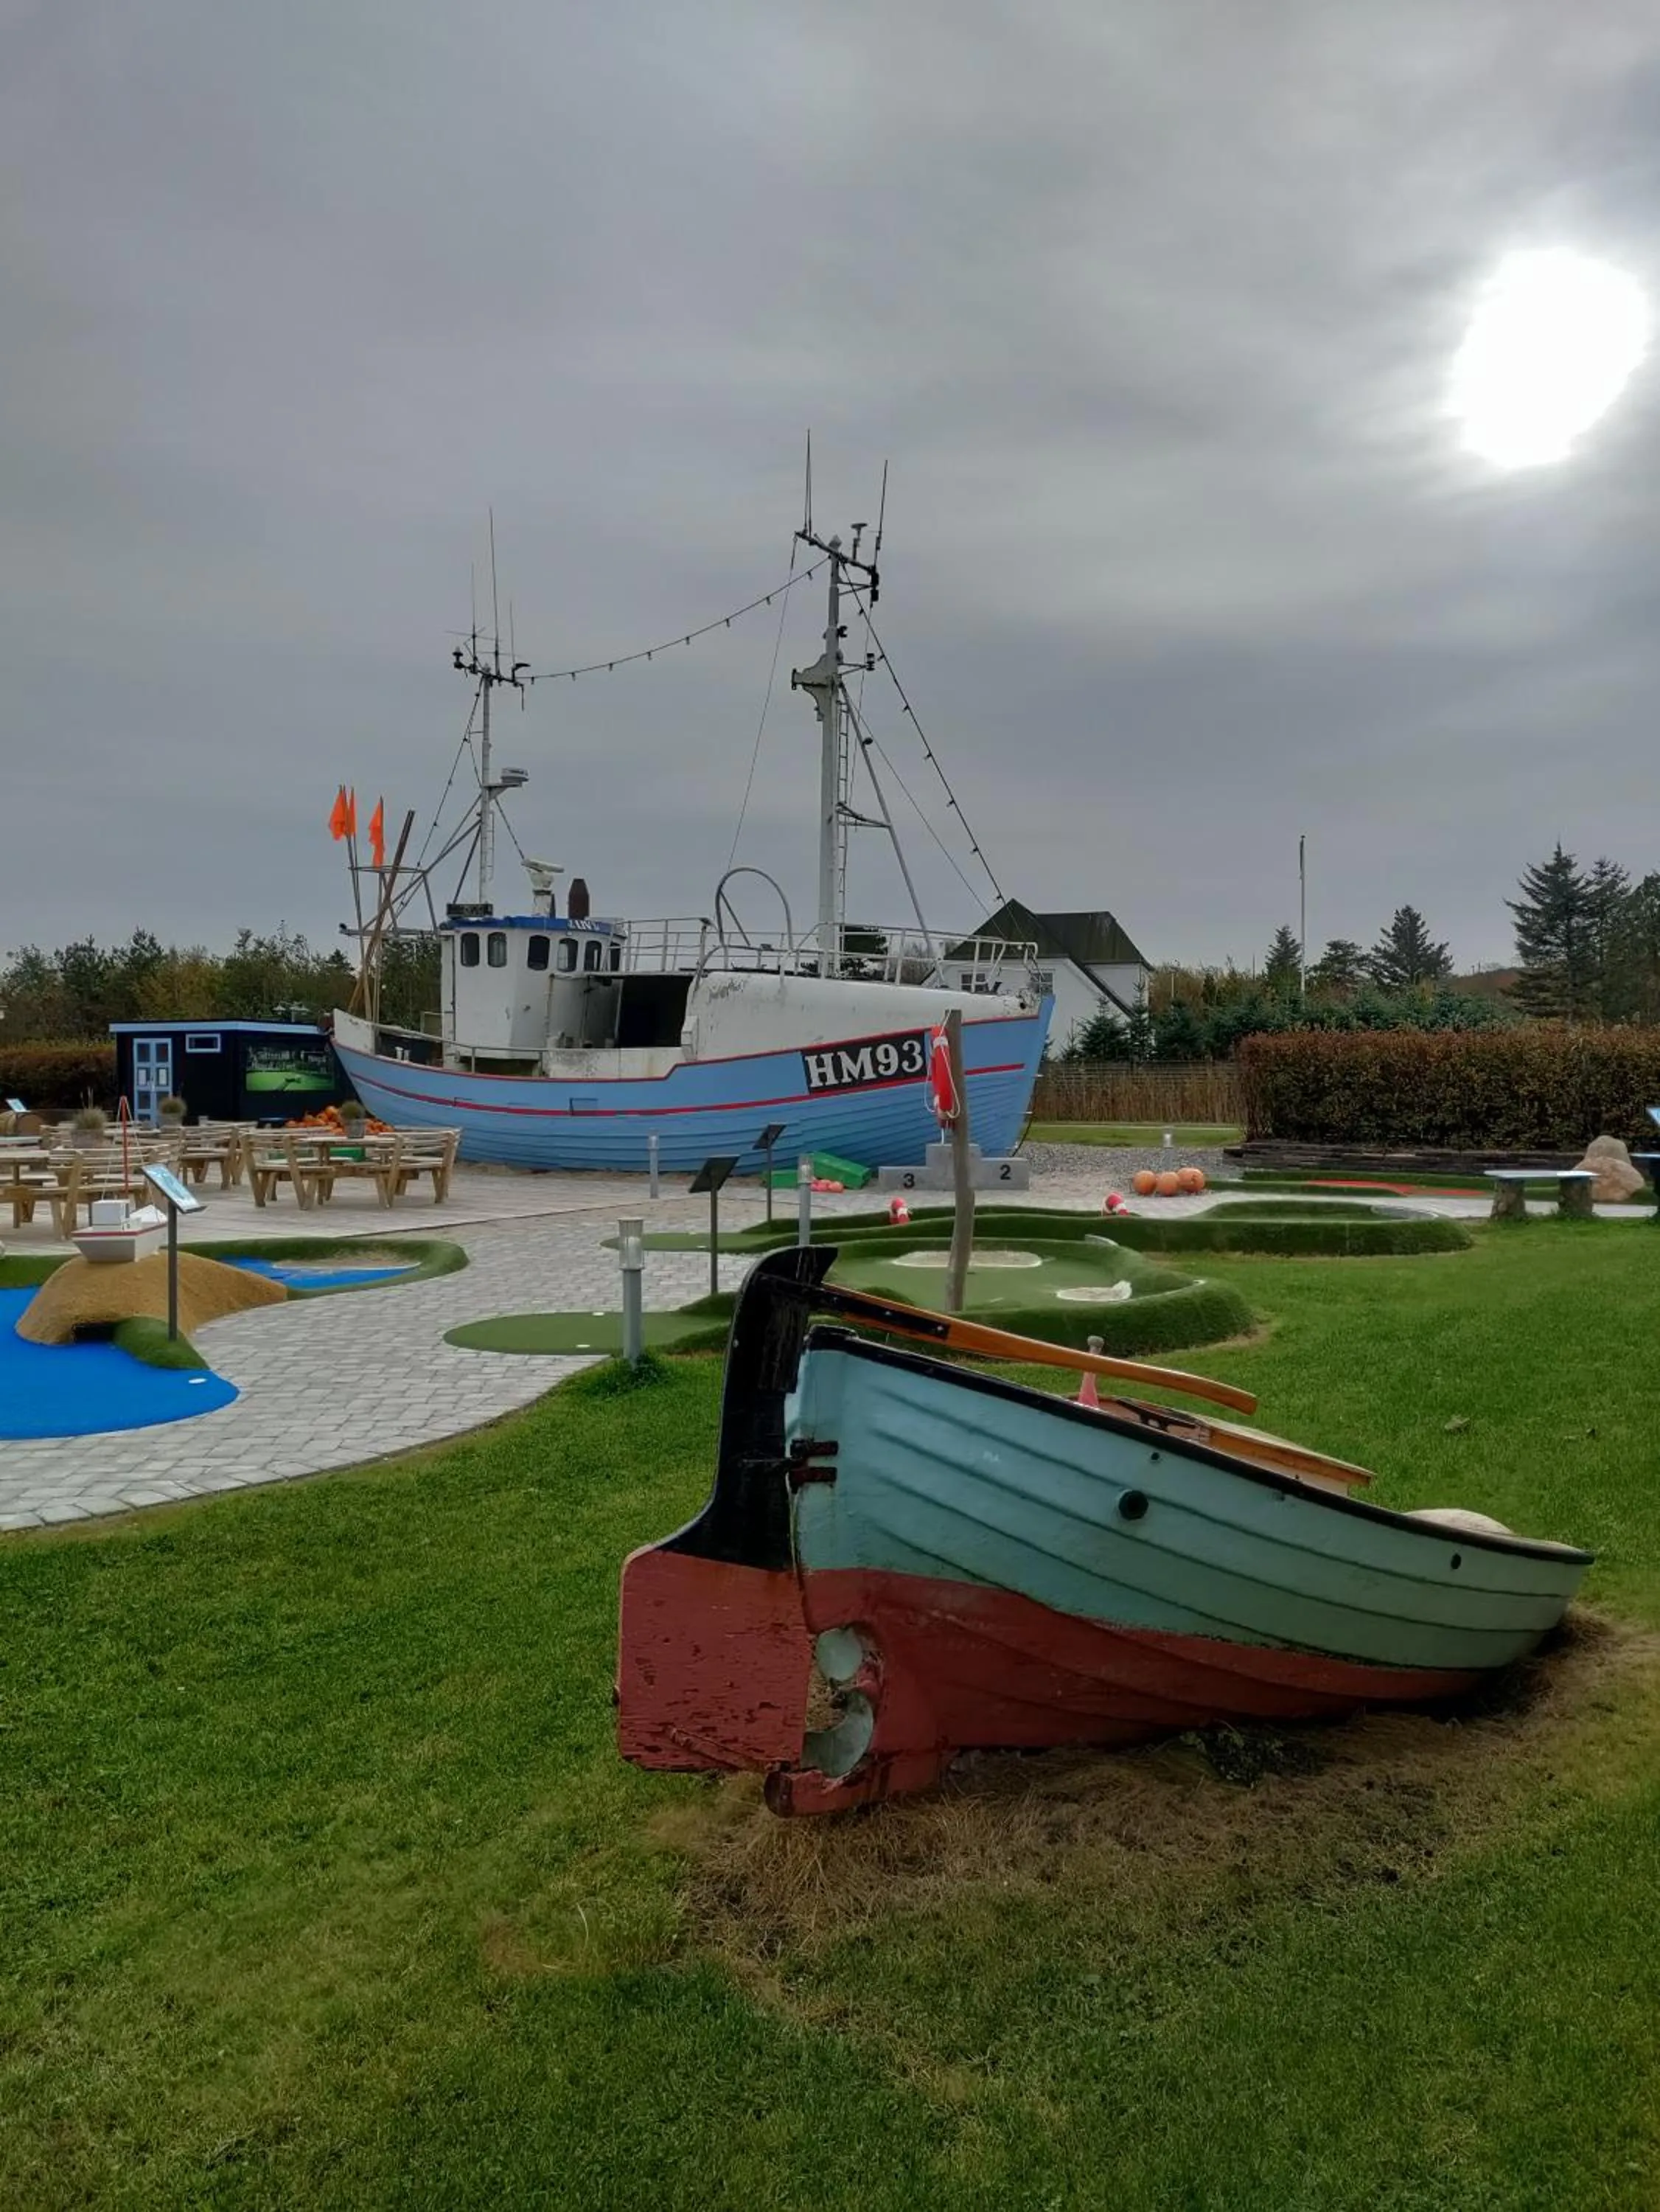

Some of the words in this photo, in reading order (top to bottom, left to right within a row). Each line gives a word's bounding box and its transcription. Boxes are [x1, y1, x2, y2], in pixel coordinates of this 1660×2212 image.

[805, 1040, 924, 1088] HM93
[1000, 1164, 1011, 1180] 2
[903, 1173, 916, 1189] 3
